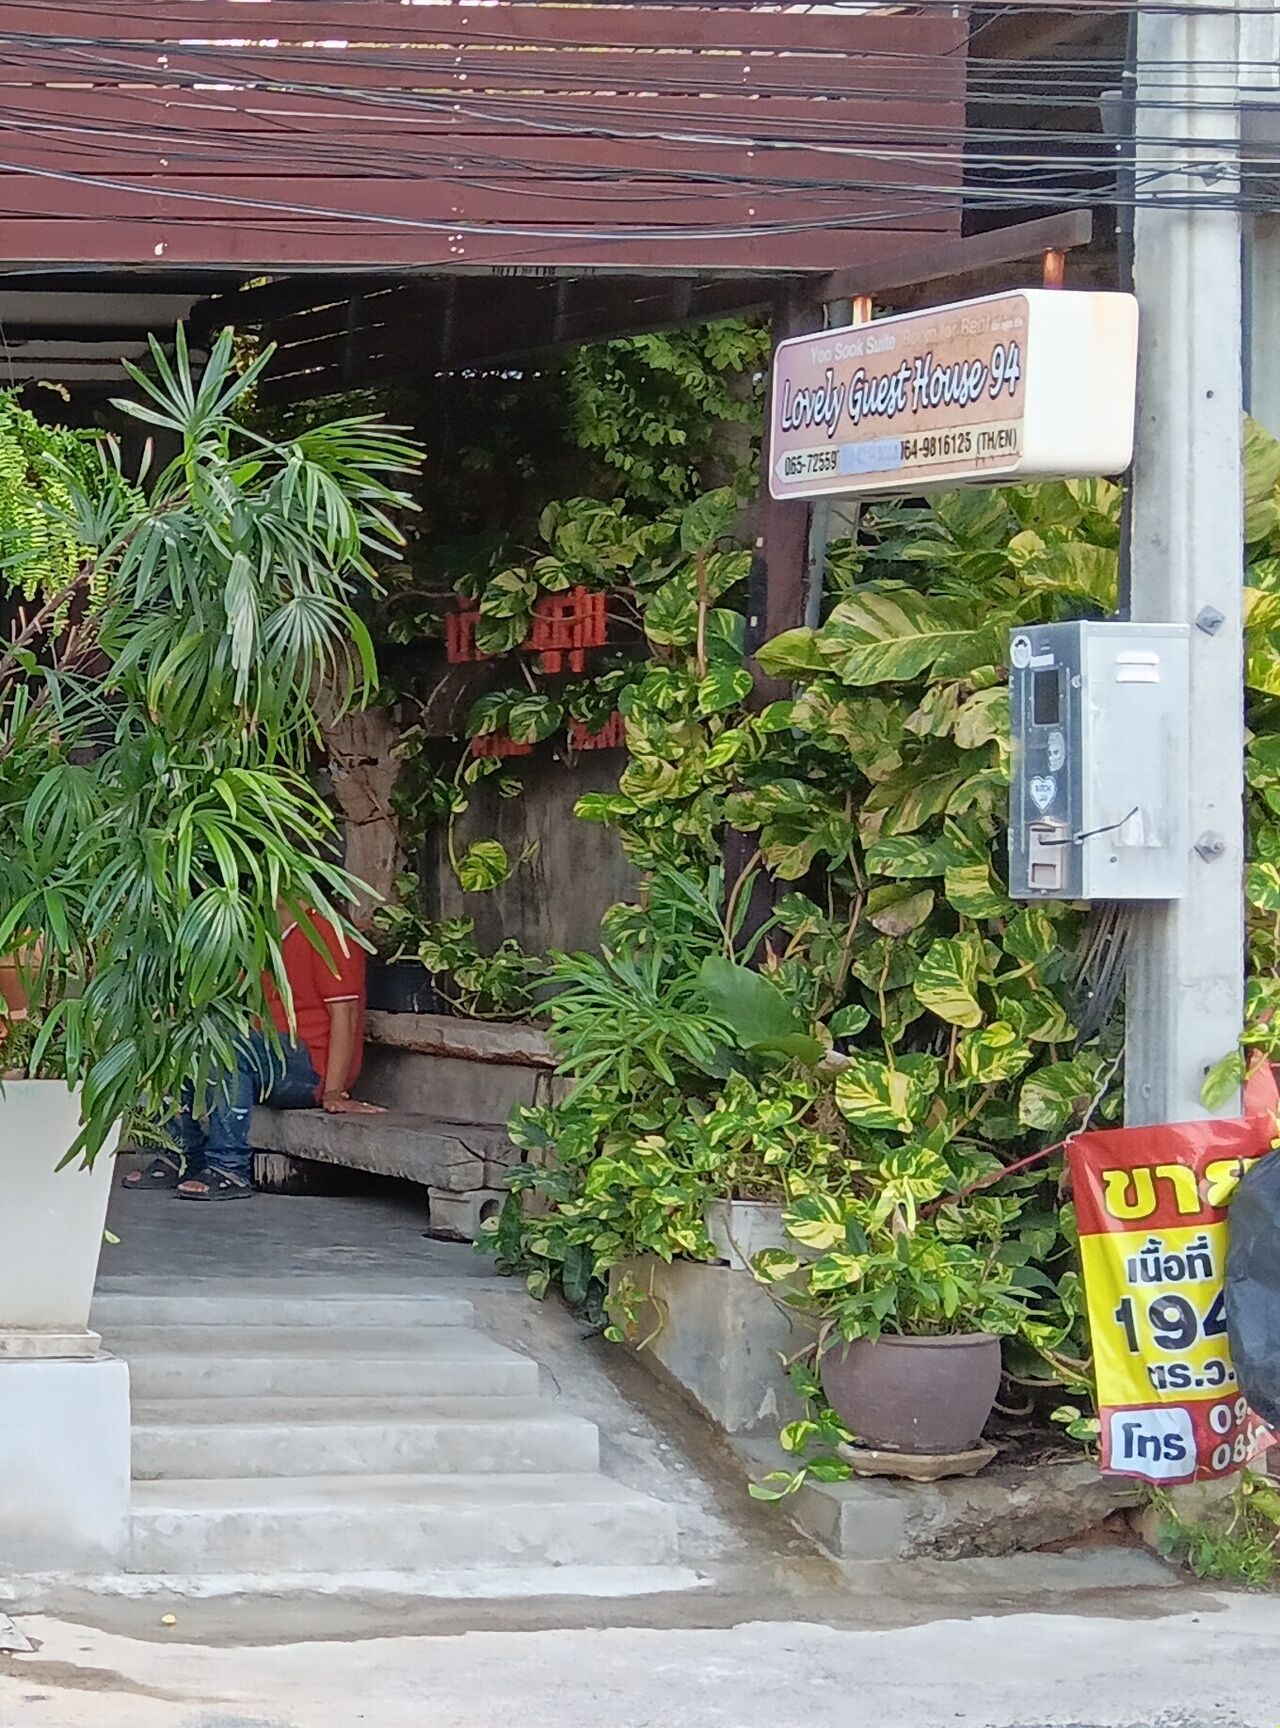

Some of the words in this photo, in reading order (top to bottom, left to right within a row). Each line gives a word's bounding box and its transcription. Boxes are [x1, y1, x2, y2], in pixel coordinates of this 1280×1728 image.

[810, 346, 832, 364] Yoo
[782, 367, 845, 439] Lovely
[847, 359, 911, 427] Guest
[912, 350, 988, 415] House
[989, 340, 1020, 400] 94
[976, 427, 1017, 455] (TH/EN)
[1127, 1235, 1213, 1284] เนื้อที่
[1123, 1421, 1187, 1462] โทร
